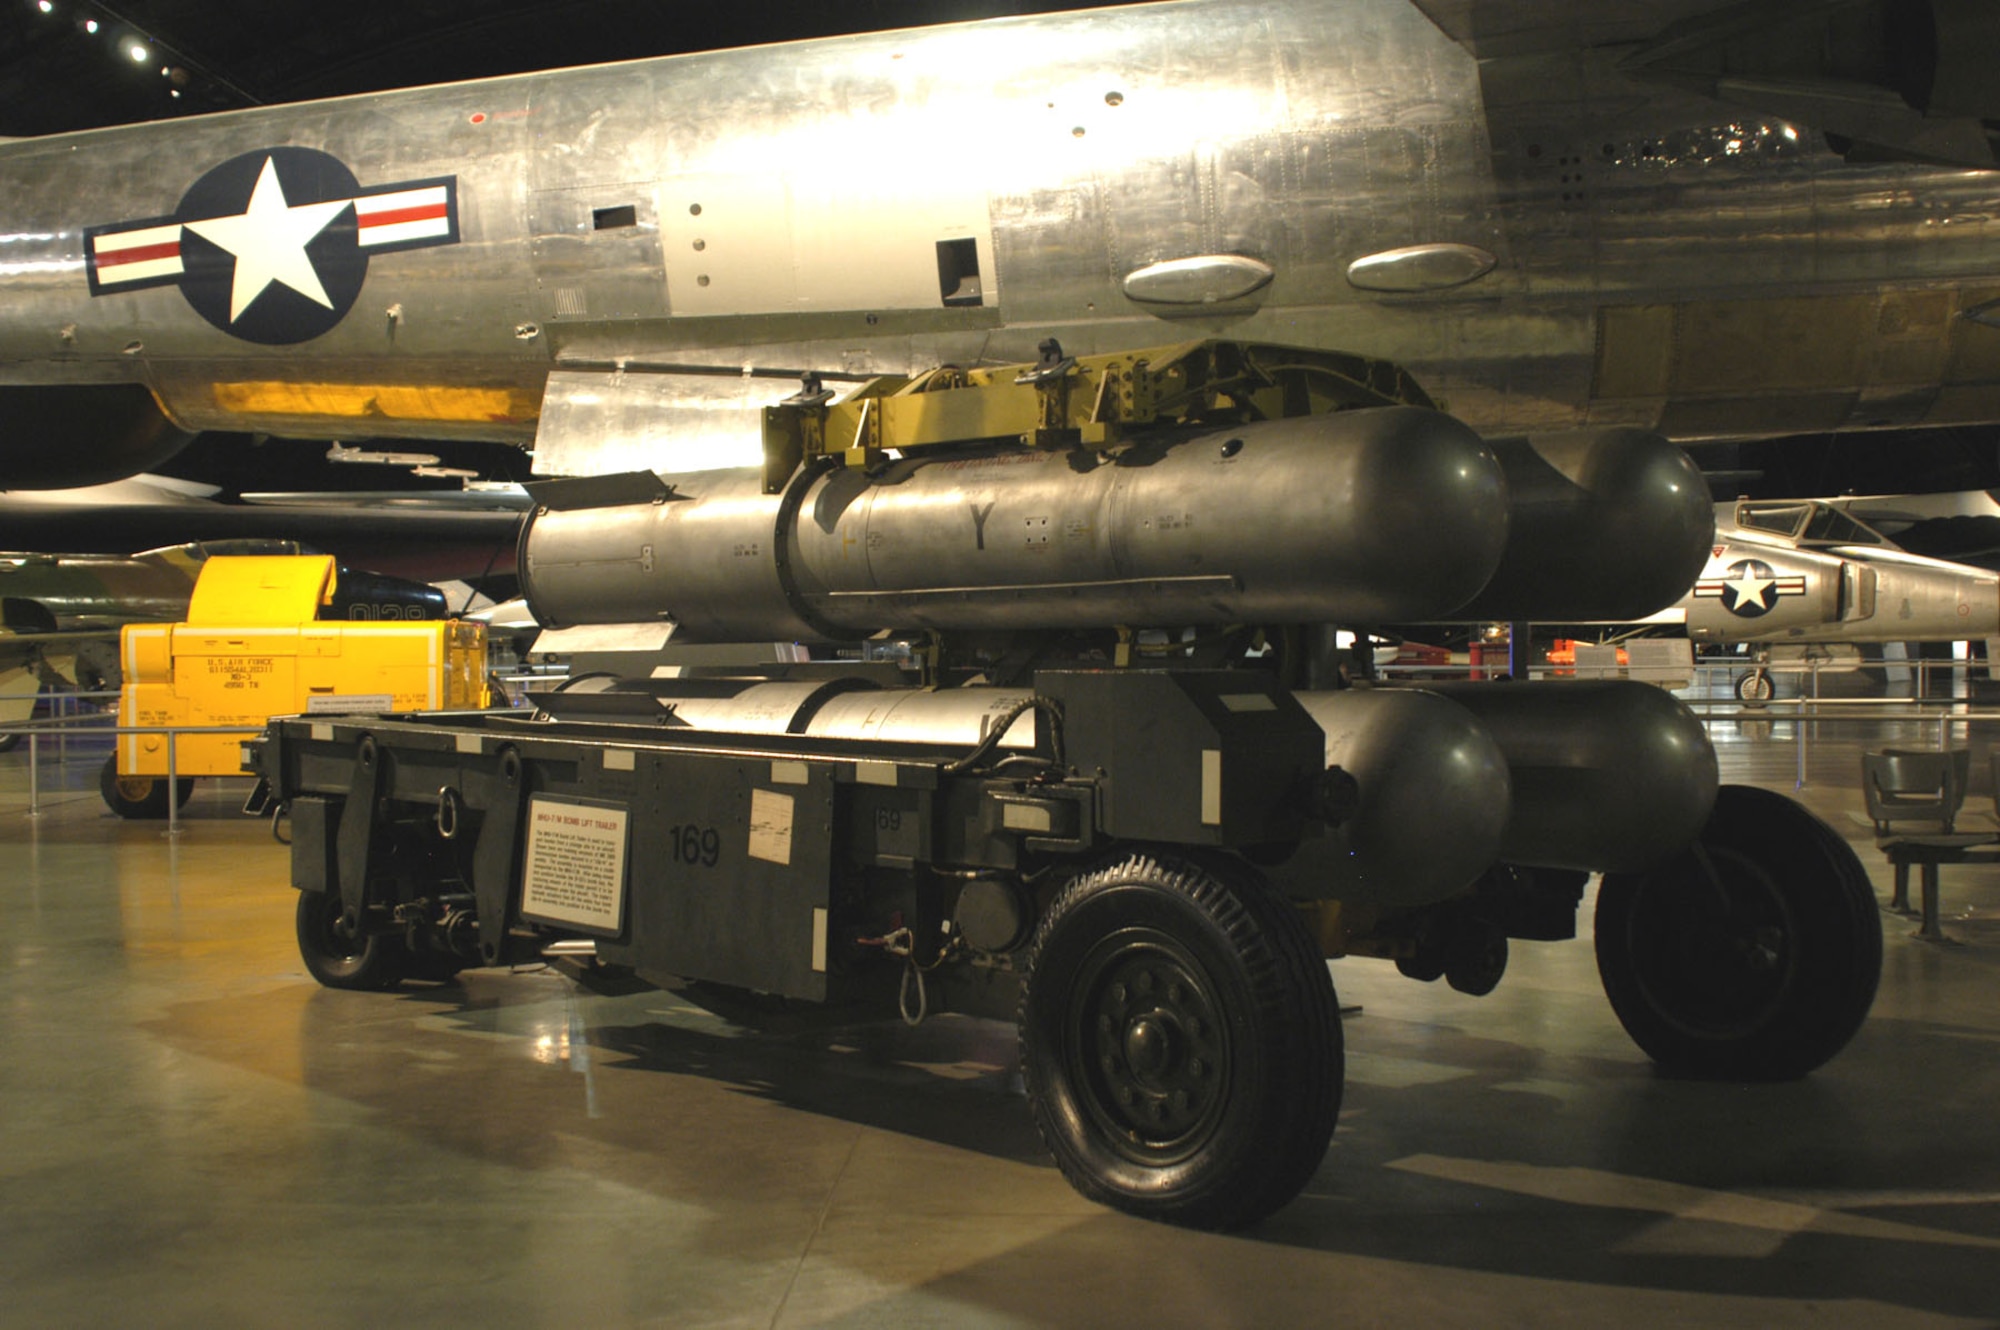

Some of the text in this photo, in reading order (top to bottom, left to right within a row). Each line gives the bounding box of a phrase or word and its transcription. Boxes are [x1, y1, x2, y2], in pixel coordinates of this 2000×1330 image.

[970, 502, 995, 550] Y
[563, 815, 580, 826] BOMB
[581, 818, 593, 827] LIFT
[595, 820, 617, 830] TRAILER
[669, 823, 721, 868] 169
